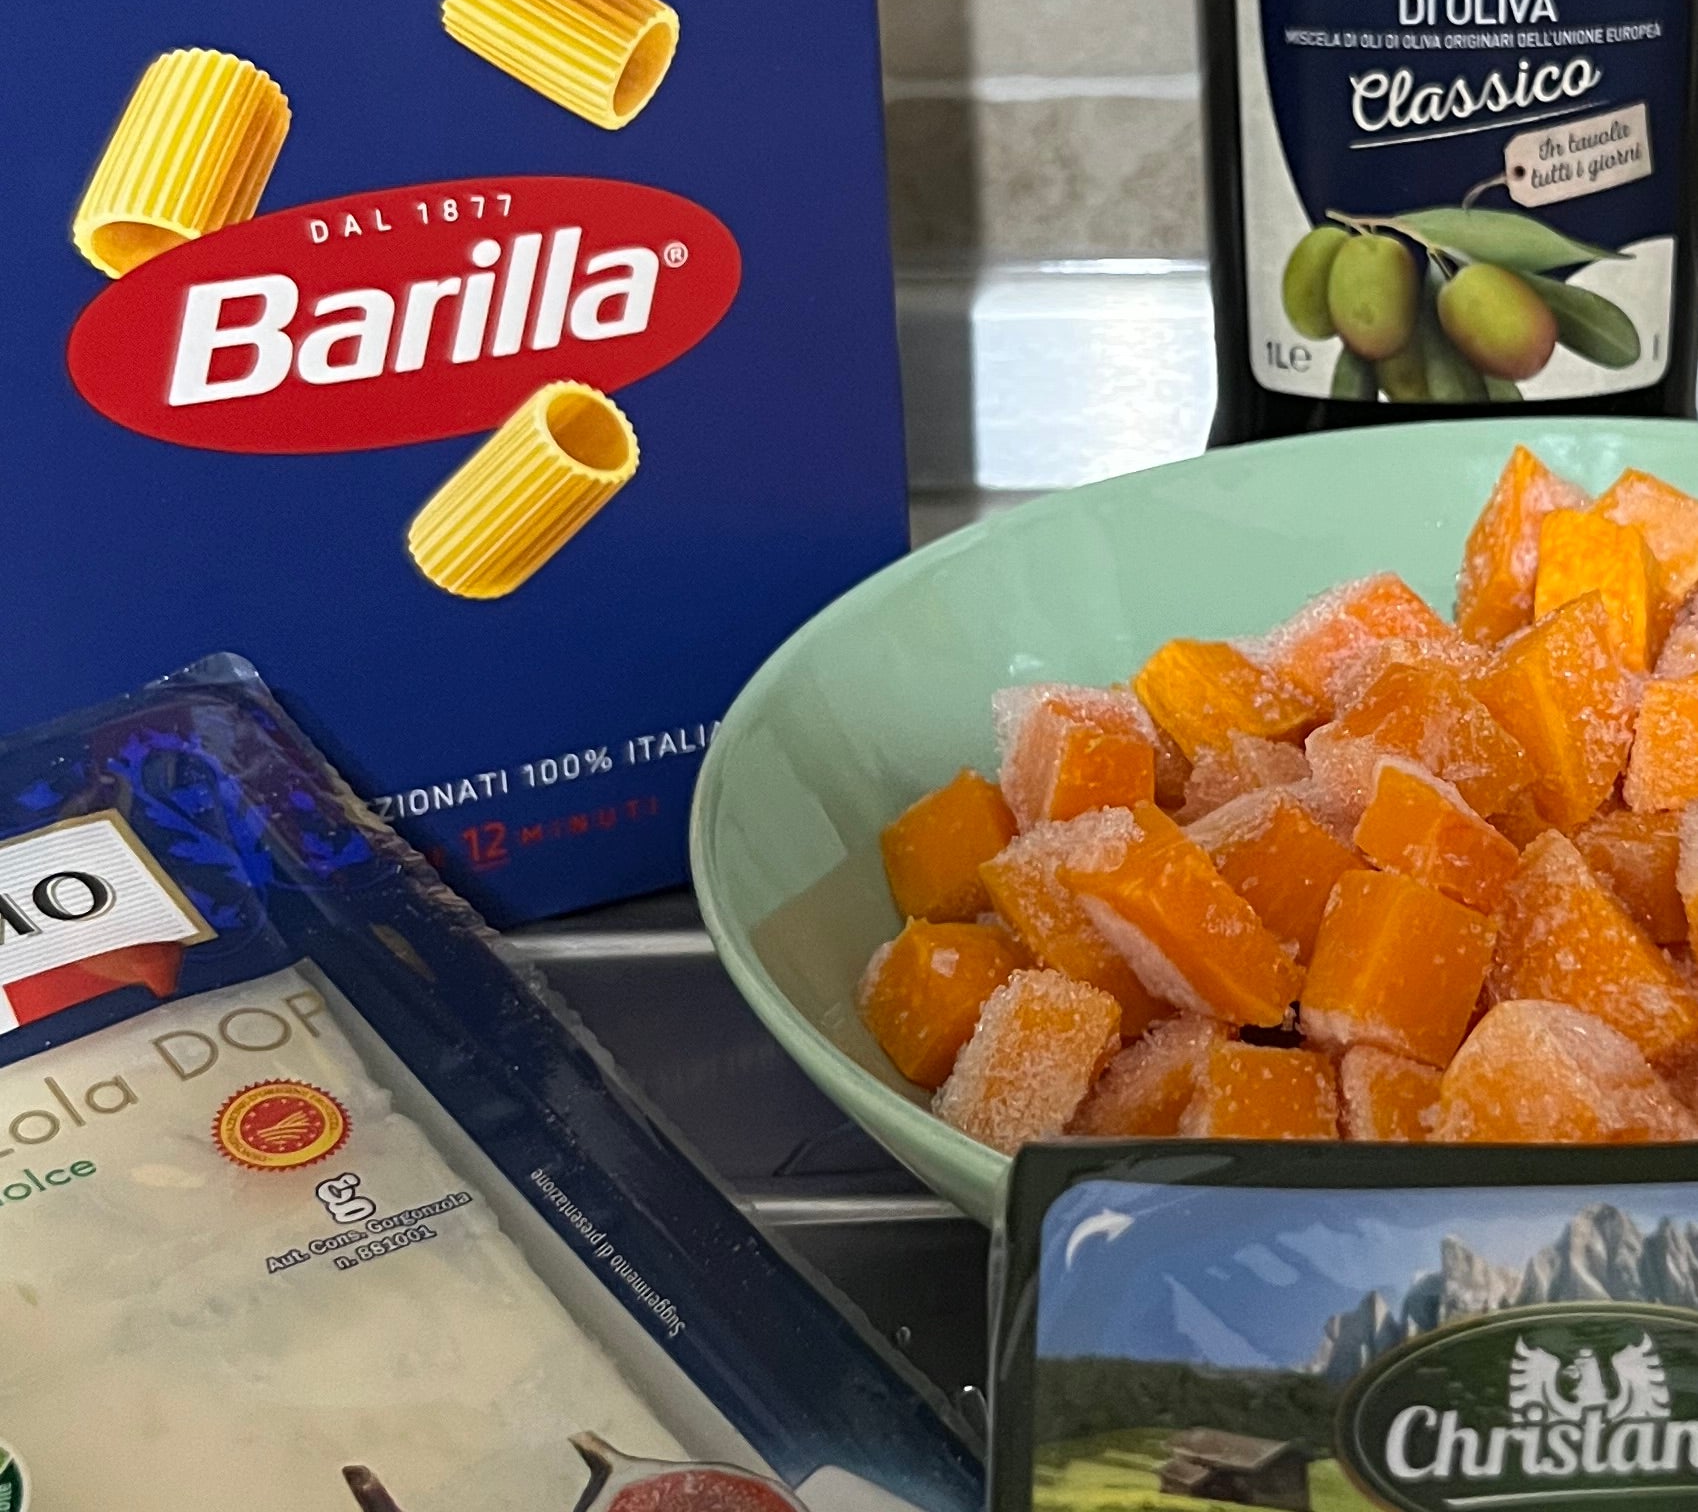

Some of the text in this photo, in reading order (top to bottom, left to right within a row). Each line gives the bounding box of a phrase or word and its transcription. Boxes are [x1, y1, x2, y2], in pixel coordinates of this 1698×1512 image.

[1284, 29, 1341, 47] MISCELA
[1402, 33, 1441, 50] OLIVA
[1444, 32, 1513, 50] ORIGINARI
[1606, 23, 1662, 43] EUROPEA
[1350, 58, 1601, 131] Classico
[1531, 163, 1573, 188] tutti
[1588, 142, 1642, 181] giorni
[1568, 121, 1630, 154] tavola
[310, 193, 514, 244] DAL 1877
[373, 769, 508, 823] ZIONATI
[521, 747, 613, 788] 100%
[463, 820, 508, 865] 12
[518, 796, 659, 847] MINUTI
[0, 1074, 139, 1157] ola
[153, 990, 327, 1081] DOP
[0, 1160, 97, 1206] olce
[266, 1191, 473, 1273] Aut. Cons. Gorgonzola
[530, 1168, 686, 1337] Suggerimento di presentazione
[334, 1255, 359, 1271] n.
